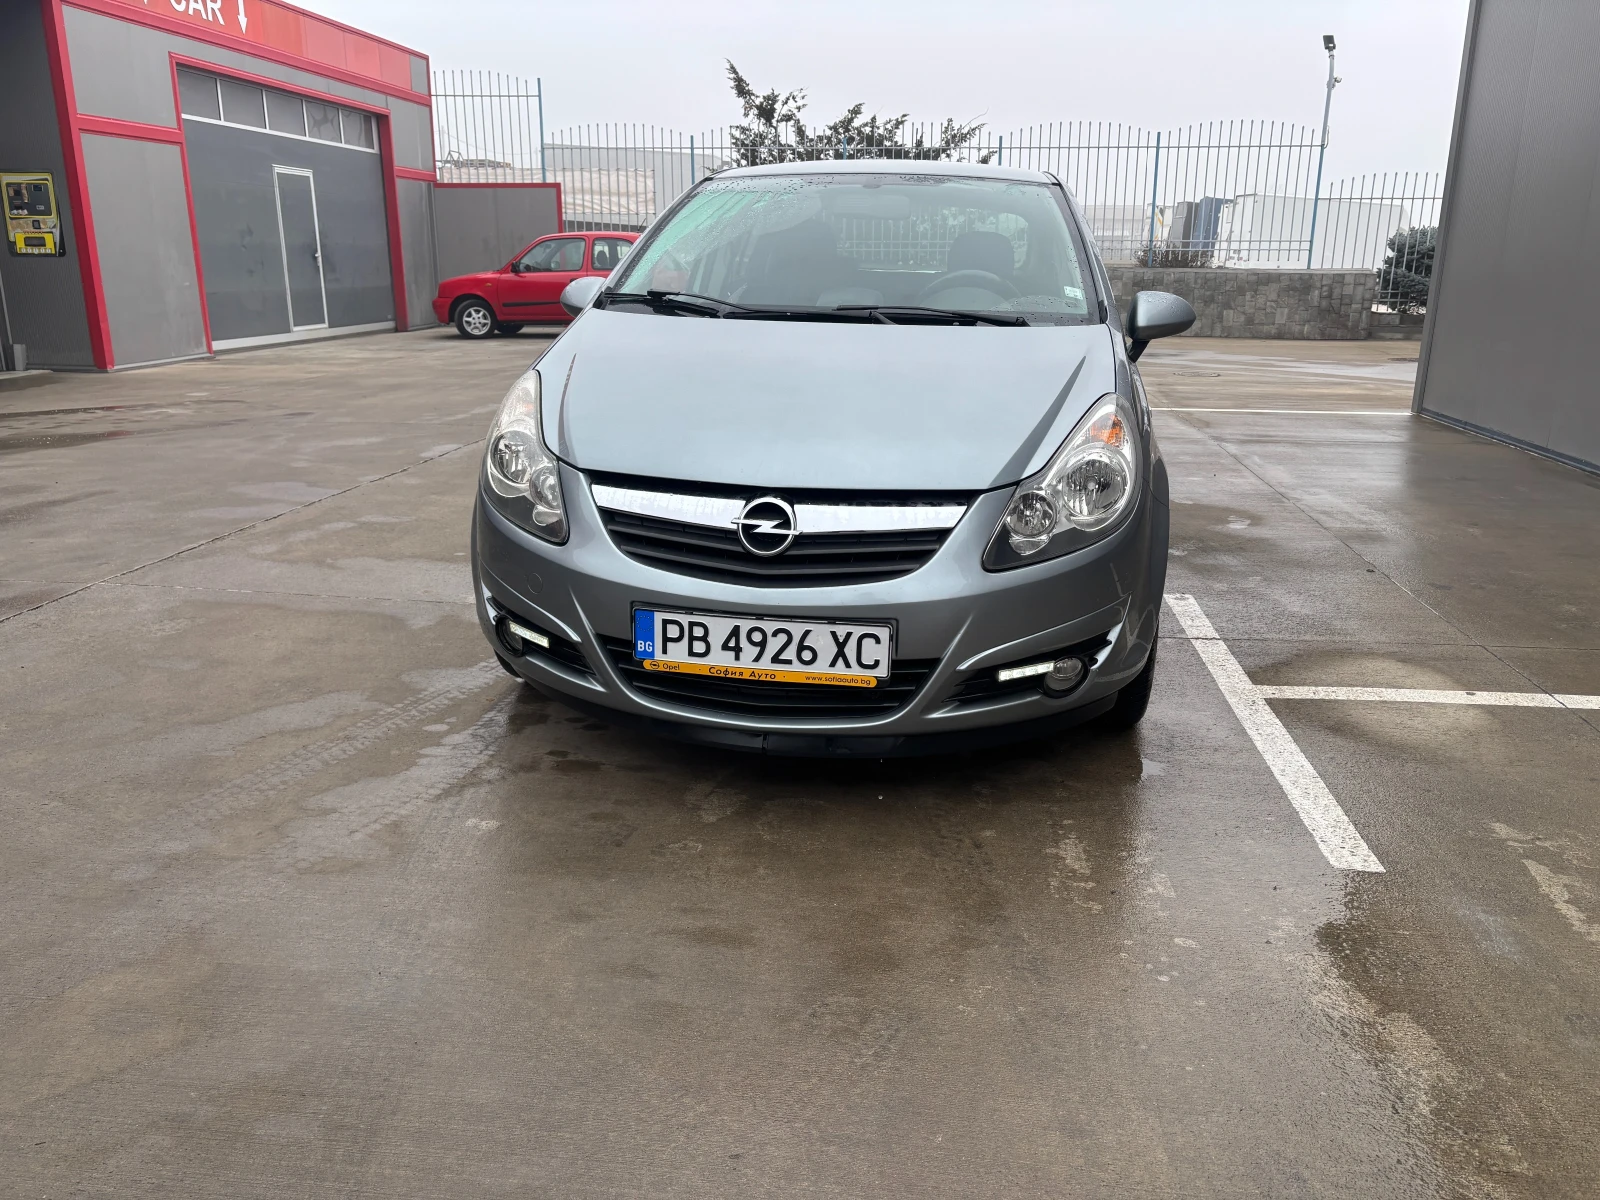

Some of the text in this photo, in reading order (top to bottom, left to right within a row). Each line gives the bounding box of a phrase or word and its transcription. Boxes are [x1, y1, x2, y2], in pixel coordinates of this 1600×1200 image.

[637, 640, 653, 652] BG
[661, 618, 882, 670] PB 4926 XC
[662, 663, 680, 671] Opel
[708, 666, 777, 680] София Ауто
[804, 674, 871, 686] www.sofiaauto.bg
